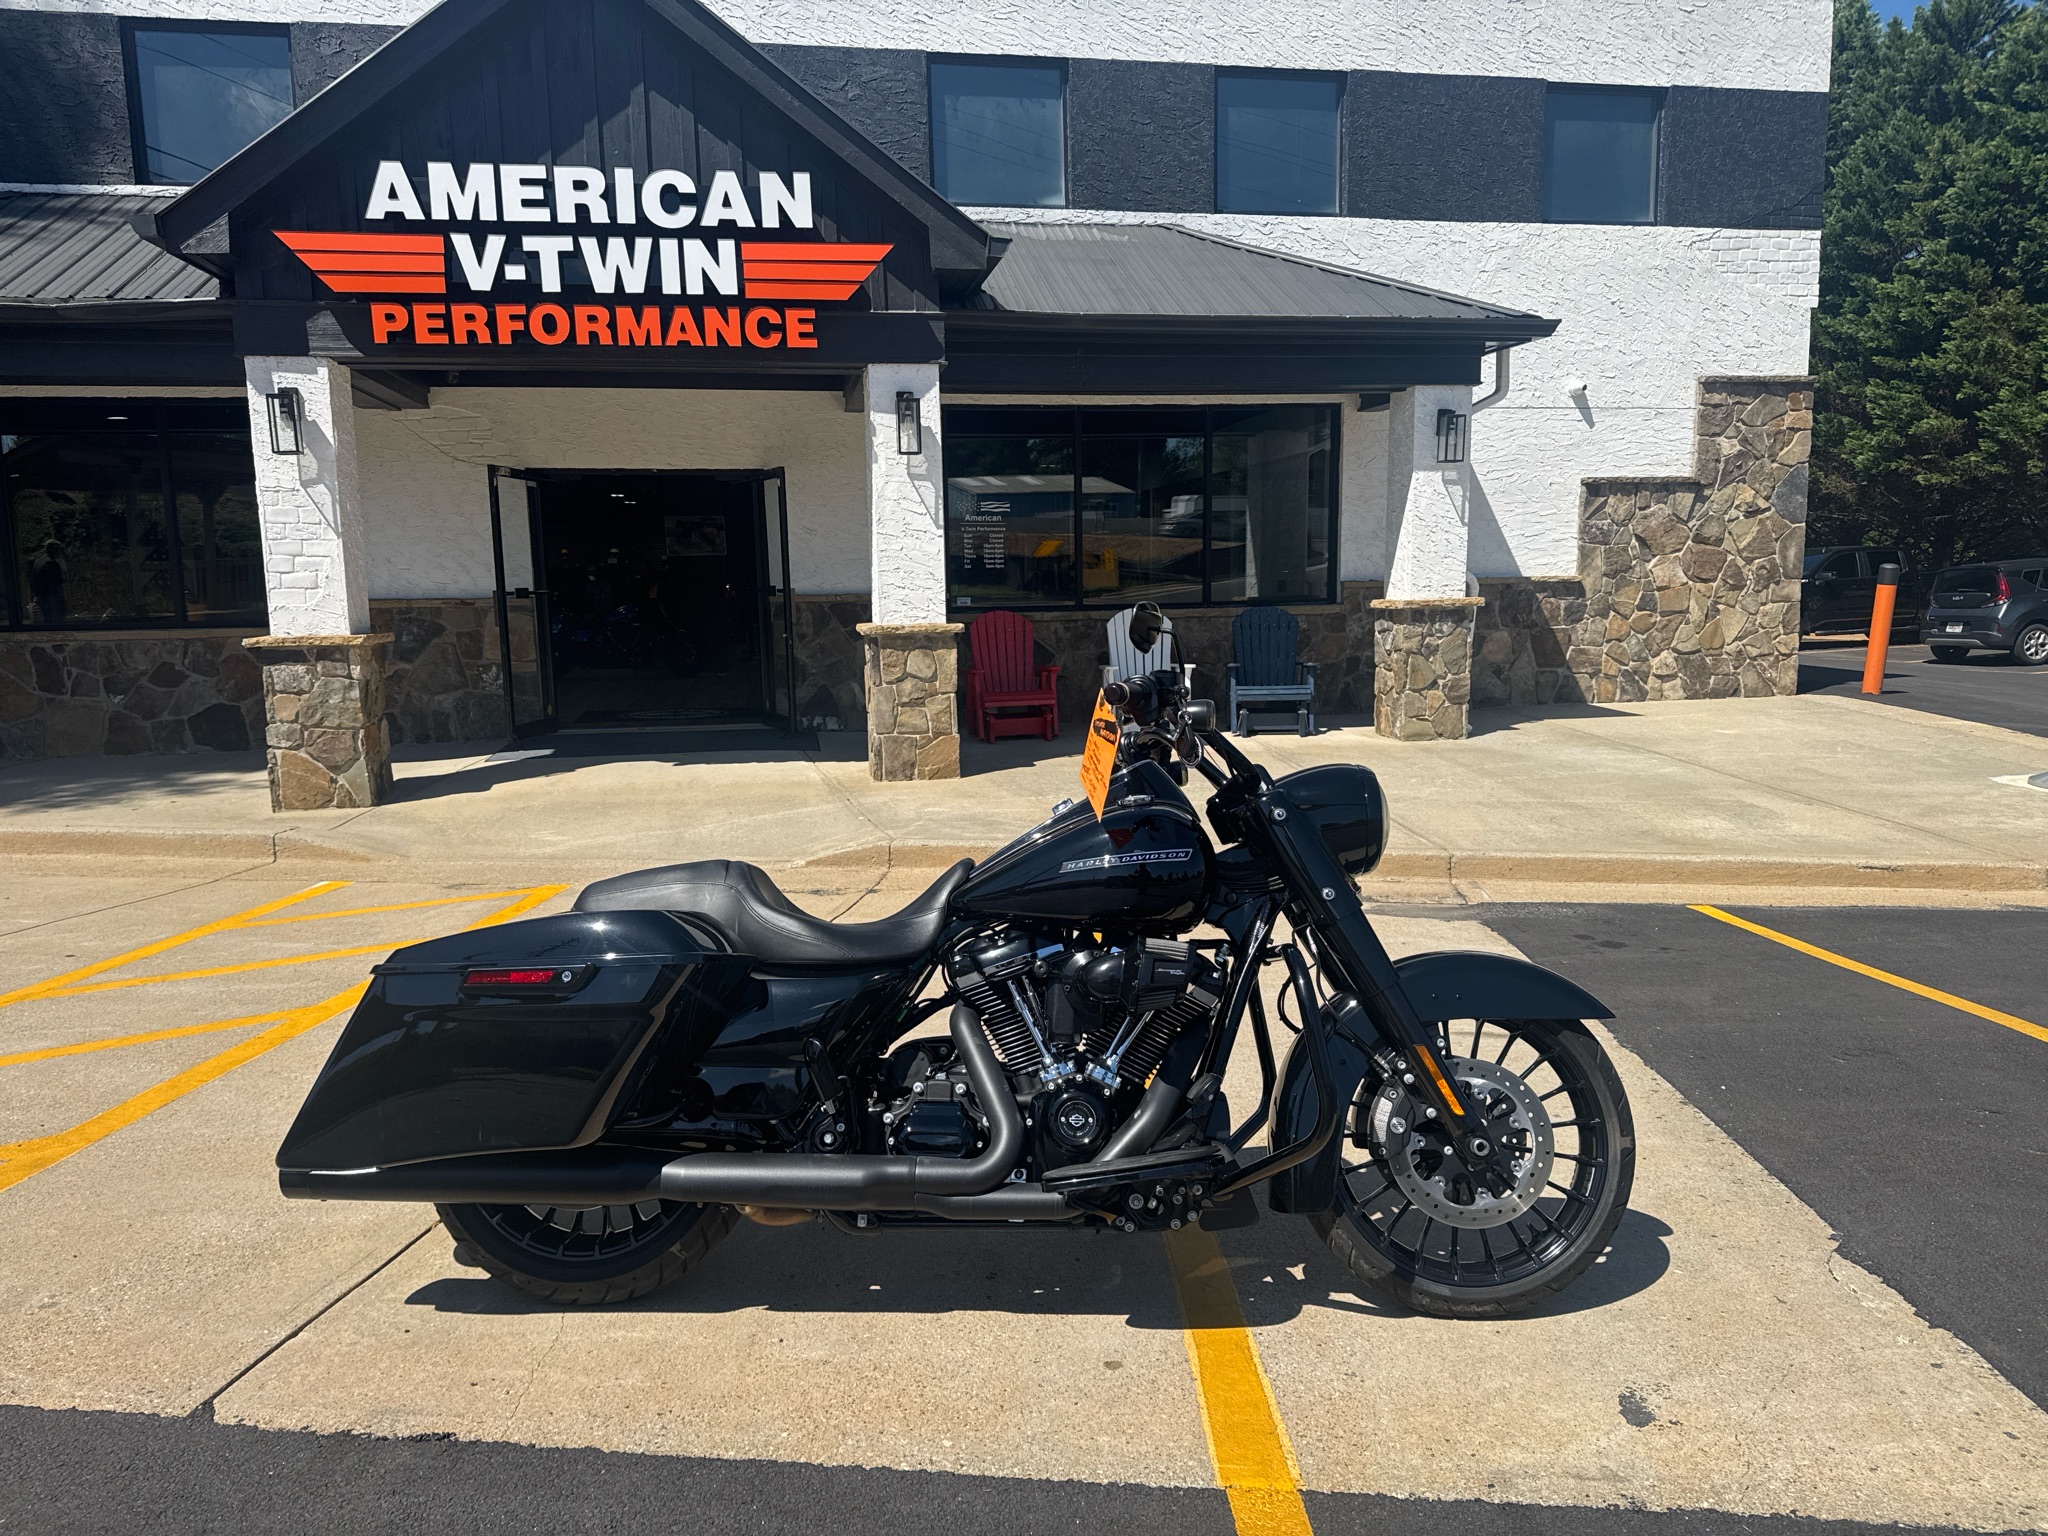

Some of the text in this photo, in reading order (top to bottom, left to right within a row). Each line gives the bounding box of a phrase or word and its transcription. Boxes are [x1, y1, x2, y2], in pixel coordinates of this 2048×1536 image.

[364, 160, 814, 229] AMERICAN
[450, 232, 739, 295] V-TWIN
[370, 302, 819, 349] PERFORMANCE
